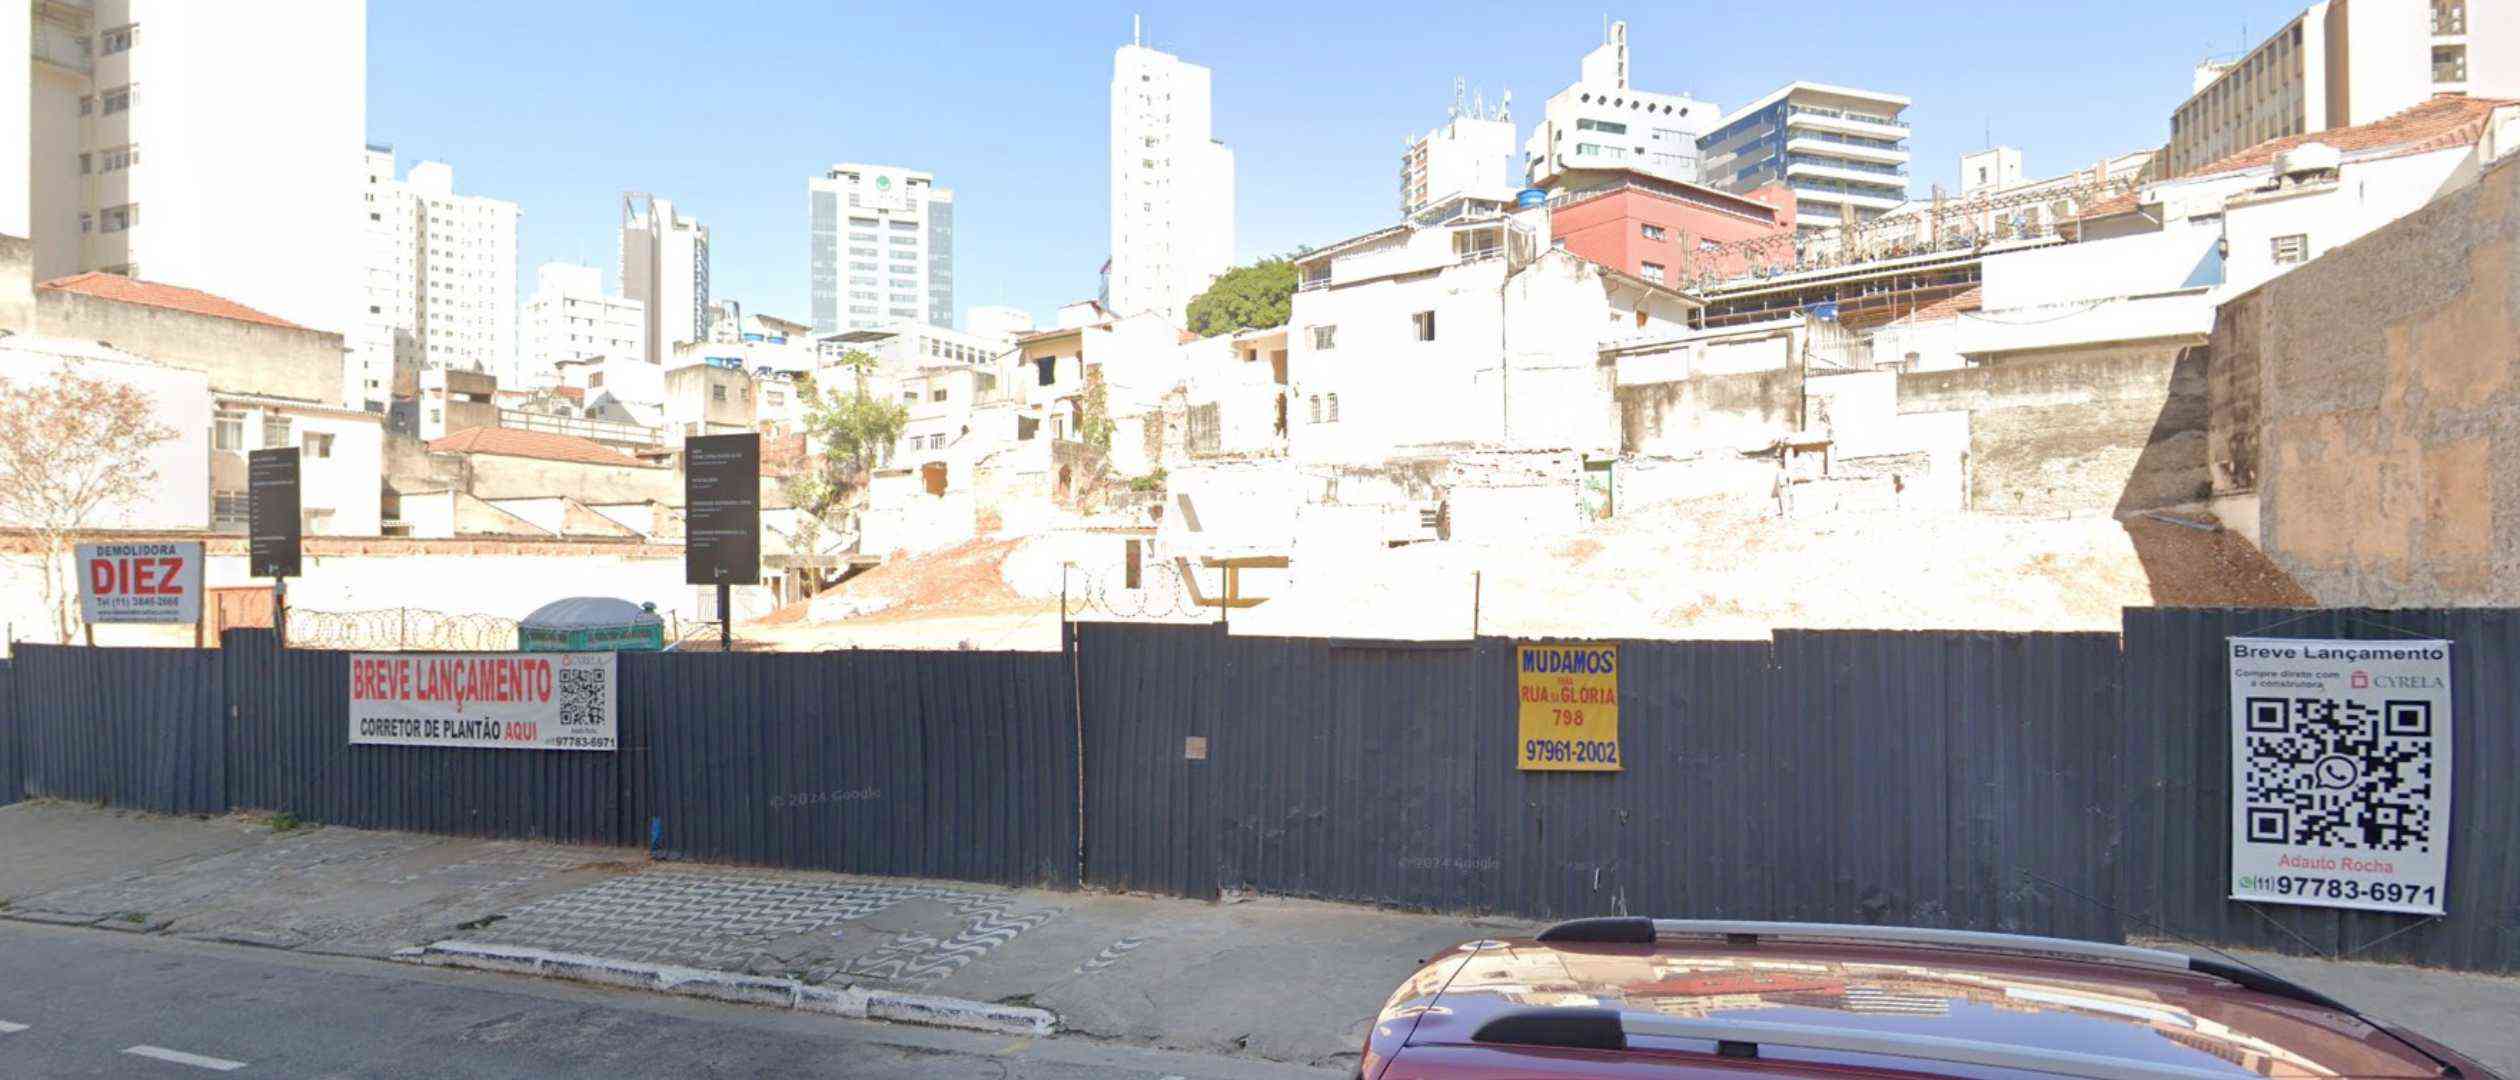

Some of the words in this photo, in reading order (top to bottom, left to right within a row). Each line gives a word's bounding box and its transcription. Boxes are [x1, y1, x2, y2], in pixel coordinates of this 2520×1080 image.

[96, 545, 176, 556] DEMOLIDORA
[90, 557, 184, 595] DIEZ
[1523, 650, 1614, 674] MUDAMOS
[2234, 645, 2296, 659] Breve
[2304, 646, 2444, 662] Lançamento
[2235, 668, 2277, 678] Compre
[2374, 675, 2445, 689] CYRELA
[353, 658, 410, 700] BREVE
[415, 658, 553, 713] LANÇAMENTO
[1521, 686, 1549, 703] RUA
[1552, 708, 1584, 726] 798
[360, 718, 421, 737] CORRETOR
[424, 719, 440, 737] DE
[443, 716, 500, 740] PLANTÃO
[504, 721, 537, 741] AQUI
[1526, 740, 1617, 762] 97961-2002
[2278, 854, 2336, 871] Adauto
[2341, 857, 2393, 873] Rocha
